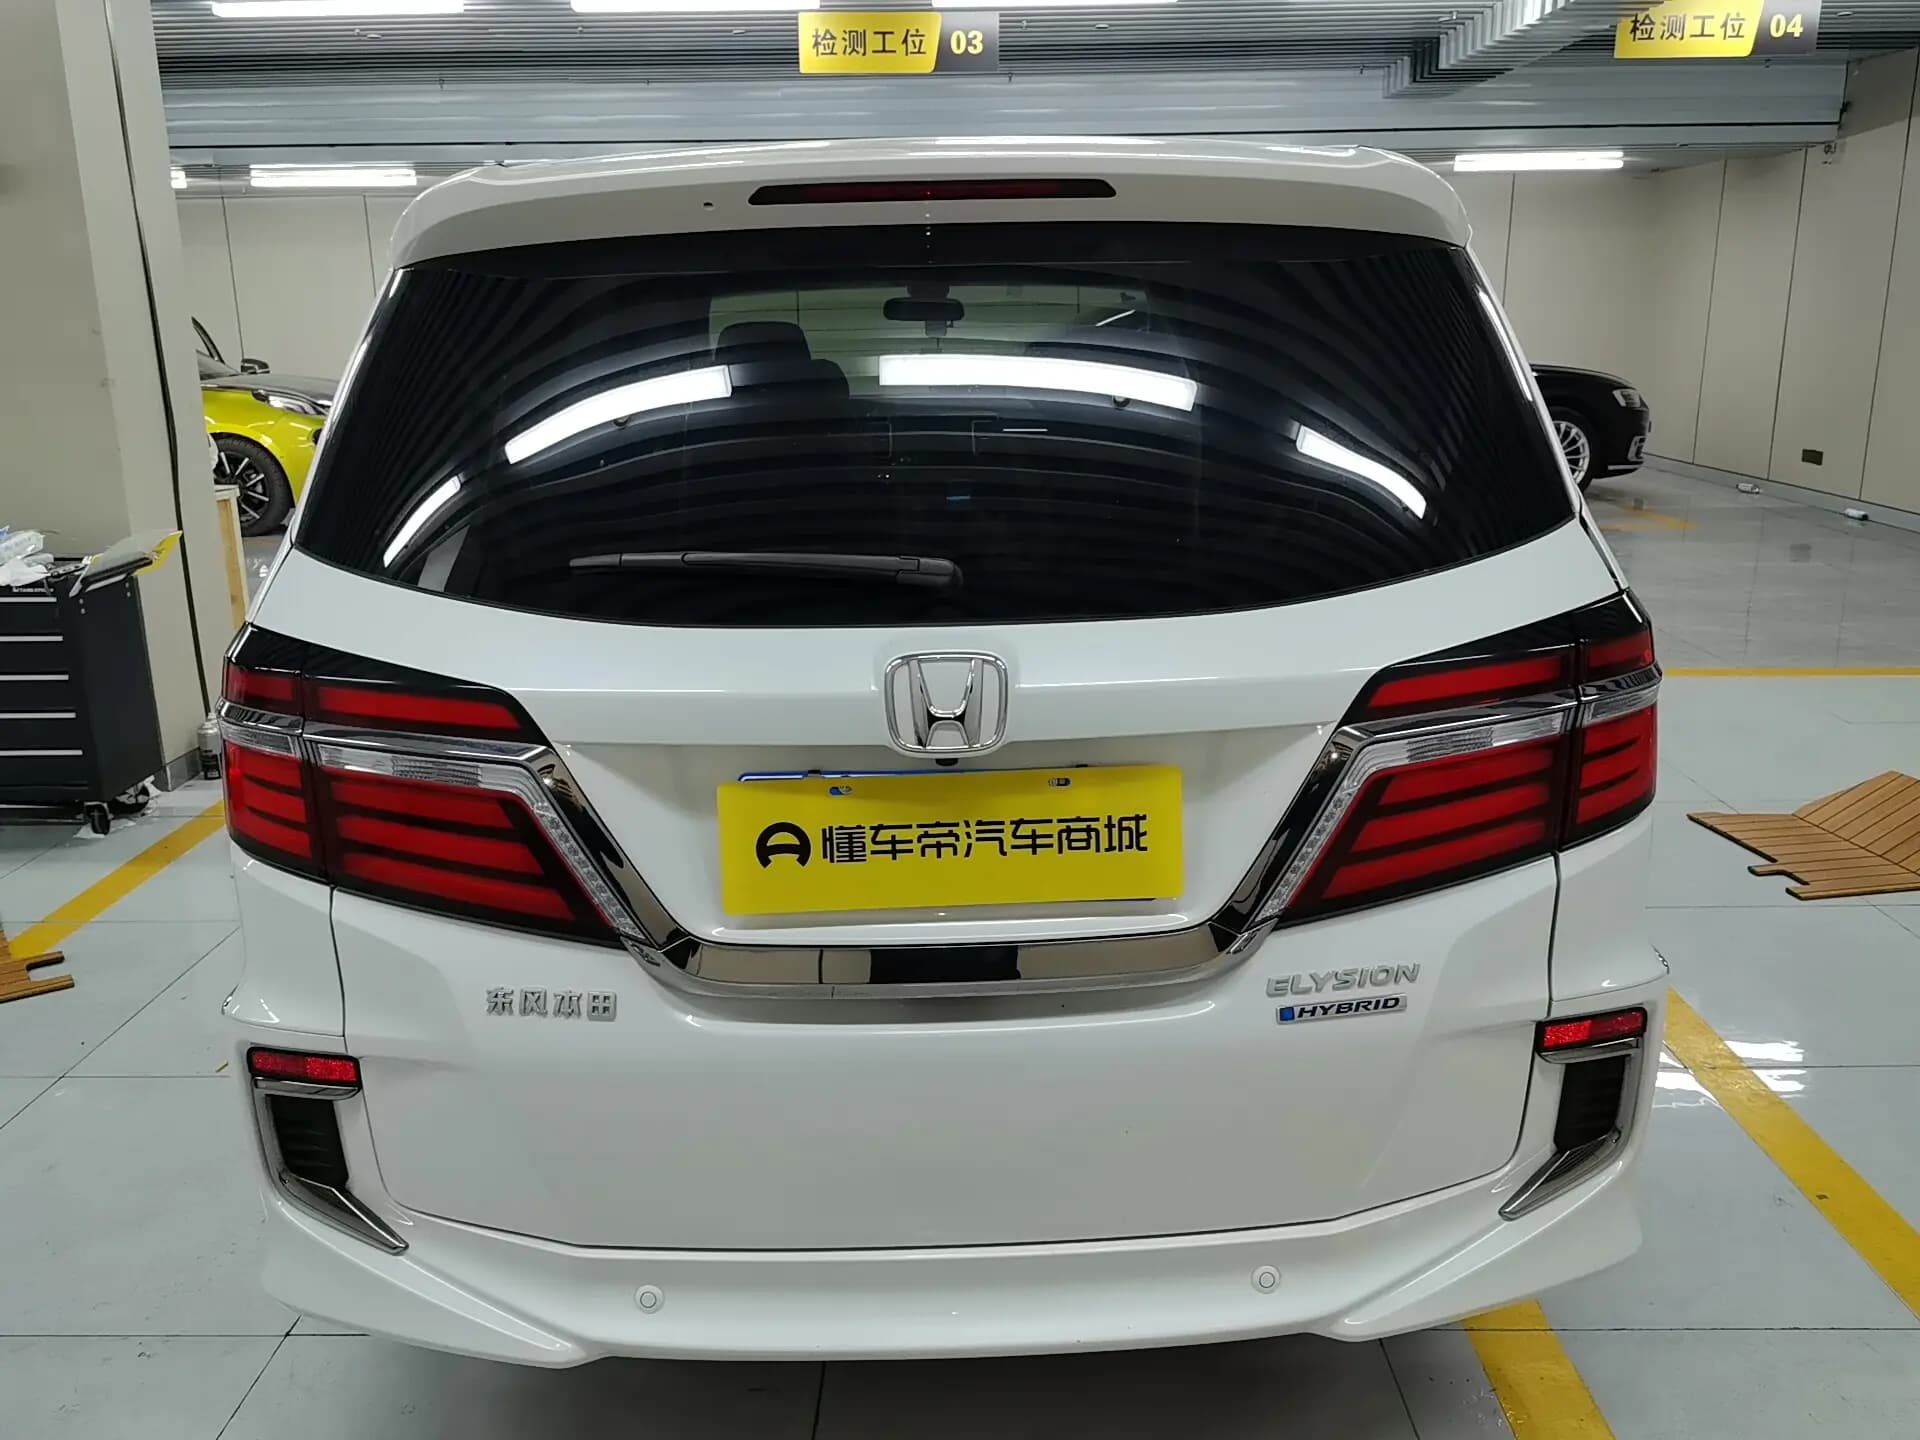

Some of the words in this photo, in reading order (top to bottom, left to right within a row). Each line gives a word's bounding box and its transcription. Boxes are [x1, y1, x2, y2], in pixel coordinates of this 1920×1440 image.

[812, 28, 927, 57] 检测工位
[950, 30, 984, 55] 03
[1630, 12, 1746, 42] 检测工位
[1769, 13, 1804, 38] 04
[821, 813, 1148, 864] 懂车帝汽车商城
[1265, 962, 1421, 997] ELYSION
[486, 986, 617, 1022] 东风本田
[1297, 997, 1401, 1019] HYBRID
